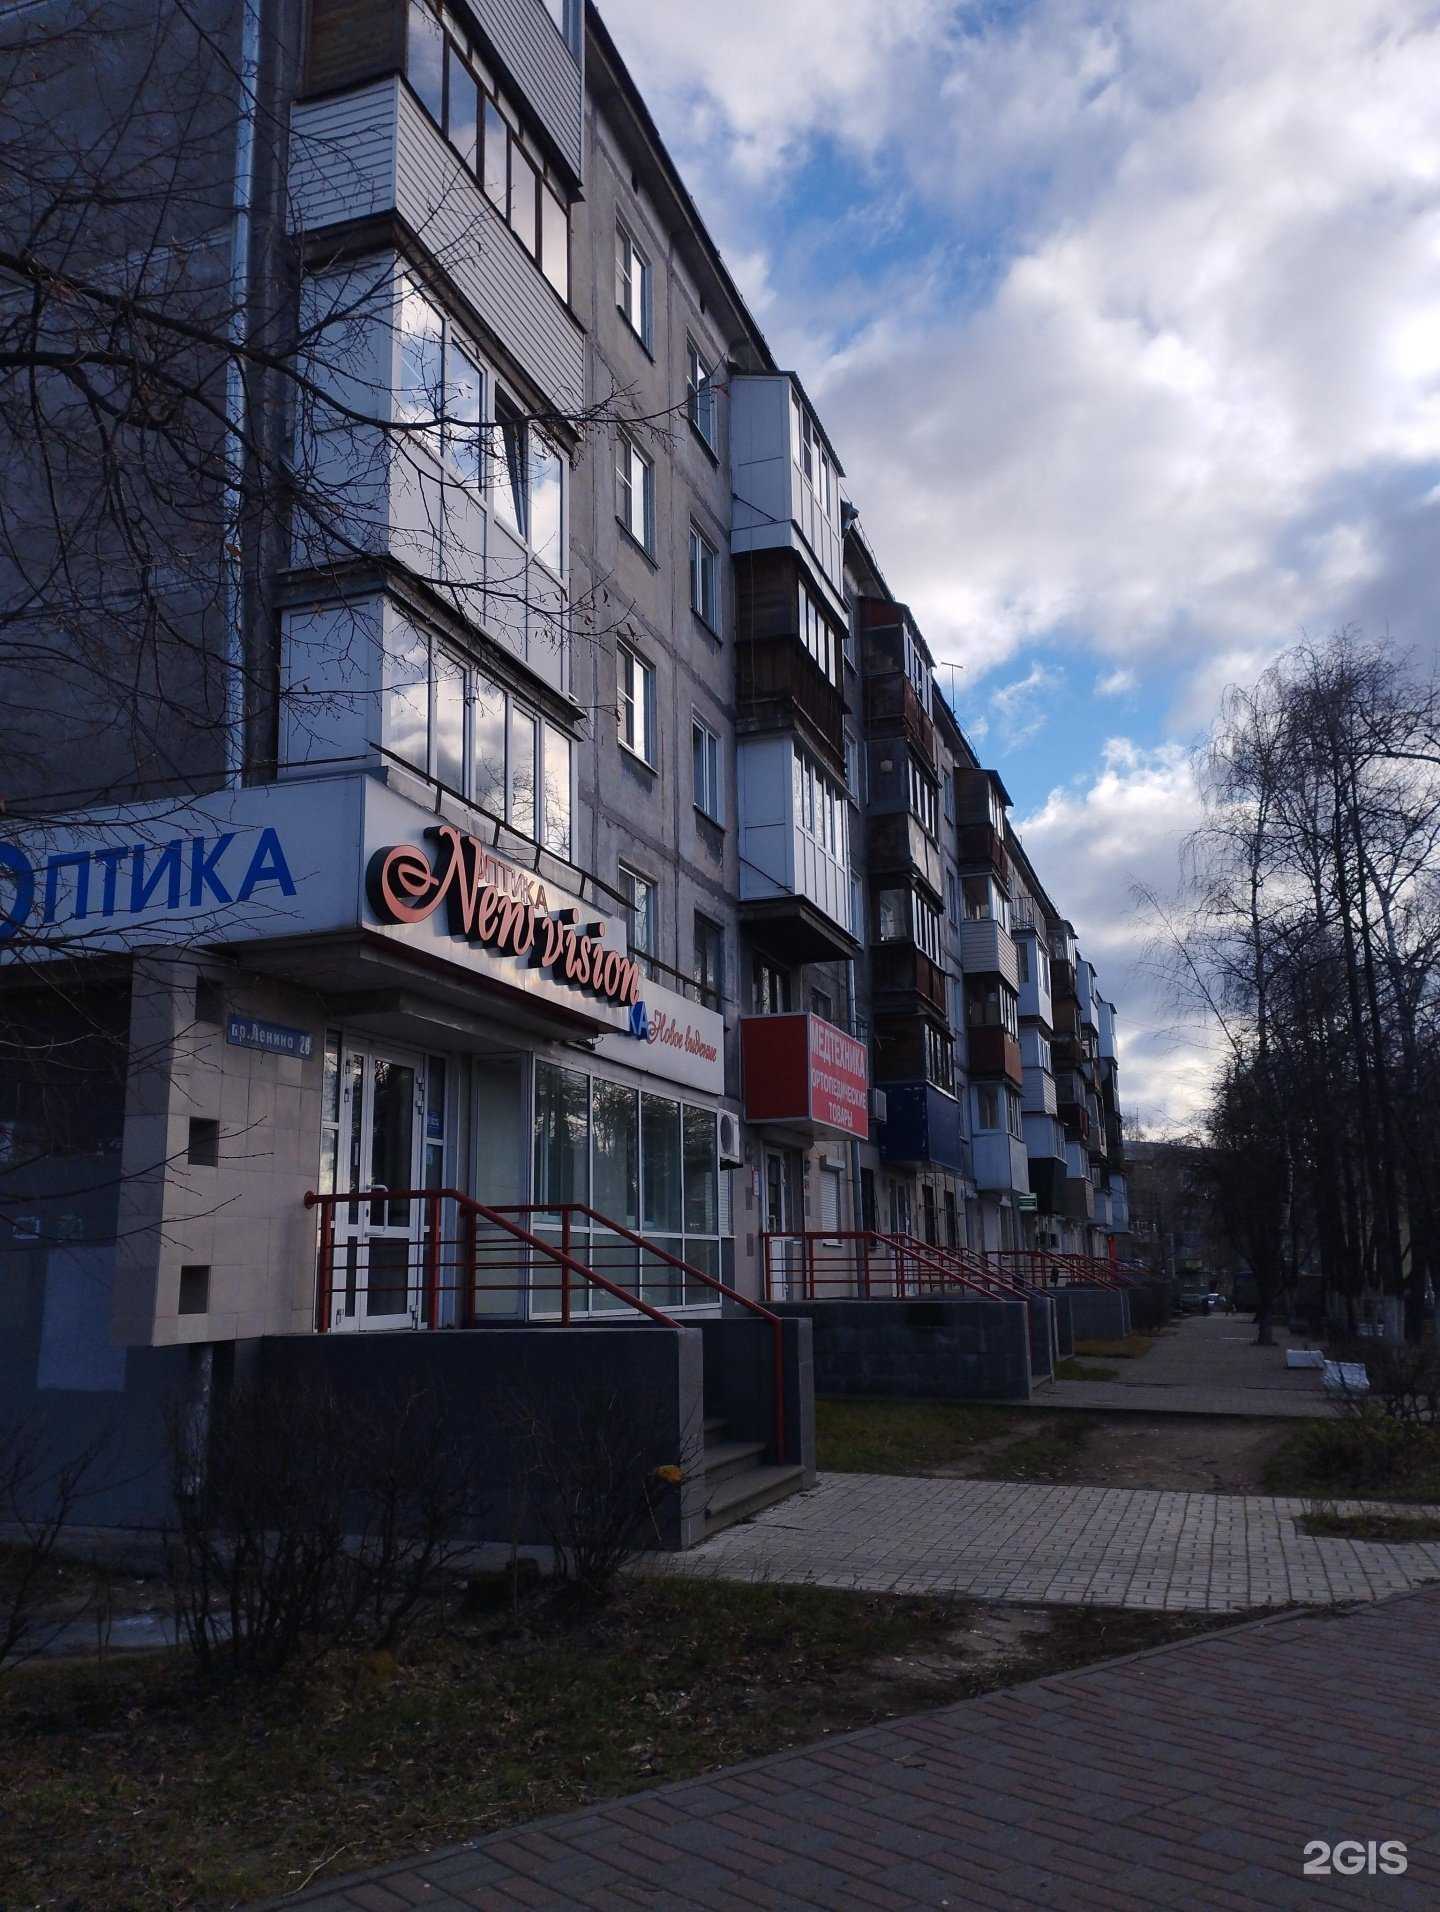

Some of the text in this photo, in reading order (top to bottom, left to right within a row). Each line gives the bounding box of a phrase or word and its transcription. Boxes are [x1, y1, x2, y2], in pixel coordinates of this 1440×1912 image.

[810, 1020, 867, 1079] МЕДТЕХНИКА
[811, 1068, 867, 1109] ОРТОПЕДИЧЕСКИЕ
[828, 1102, 853, 1128] ТОВАРЫ
